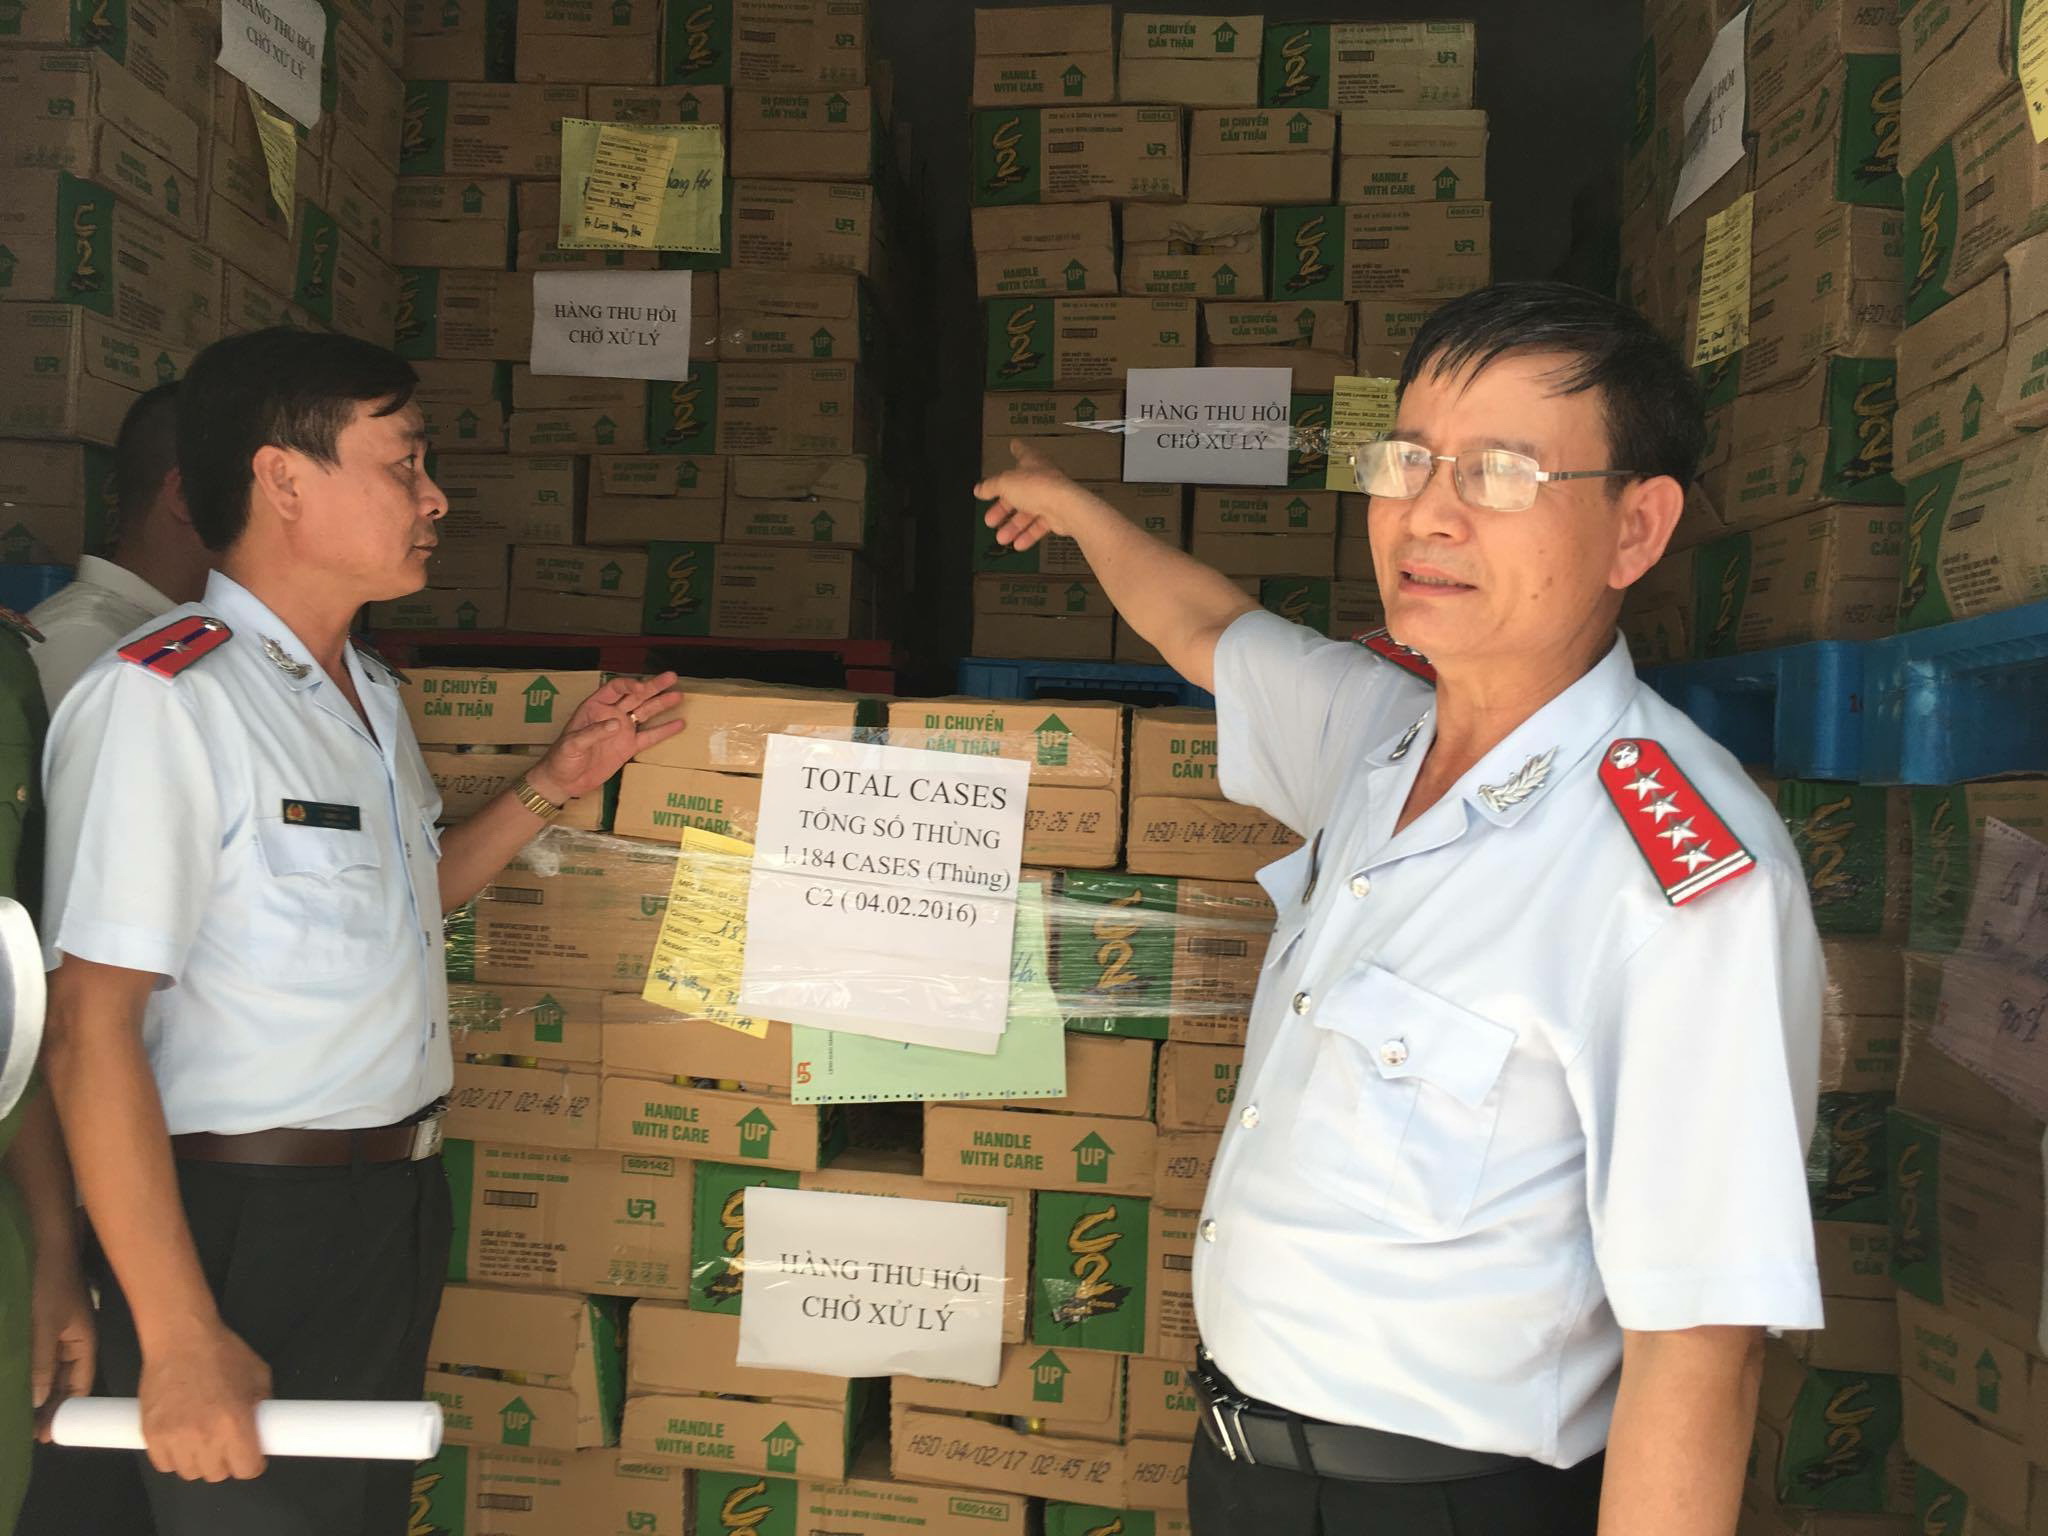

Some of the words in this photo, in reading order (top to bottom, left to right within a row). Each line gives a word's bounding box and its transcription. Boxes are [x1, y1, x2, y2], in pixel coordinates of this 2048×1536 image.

[1147, 24, 1158, 35] DI
[1218, 31, 1233, 42] UP
[1280, 29, 1312, 87] C2
[992, 117, 1022, 178] C2
[1371, 172, 1409, 184] HANDLE
[1440, 178, 1455, 190] UP
[1363, 184, 1388, 196] WITH
[1390, 184, 1416, 196] CARE
[1295, 216, 1328, 275] C2
[1067, 270, 1083, 282] UP
[1217, 274, 1233, 286] UP
[608, 306, 642, 320] THU
[1006, 304, 1038, 363] C2
[1204, 404, 1247, 422] THU
[424, 679, 437, 693] DI
[530, 690, 550, 707] UP
[925, 714, 940, 730] DI
[1170, 739, 1187, 755] DI
[1190, 740, 1218, 756] CHU
[802, 766, 900, 798] TOTAL
[910, 778, 1008, 810] CASES
[667, 792, 724, 814] HANDLE
[652, 809, 691, 829] WITH
[695, 815, 732, 833] CARE
[842, 852, 920, 878] CASES
[805, 886, 834, 908] C2
[1092, 888, 1143, 990] C2
[1214, 1063, 1230, 1079] DI
[645, 1102, 699, 1123] HANDLE
[632, 1120, 671, 1141] WITH
[672, 1123, 710, 1144] CARE
[744, 1123, 767, 1142] UP
[973, 1130, 1032, 1150] HANDLE
[960, 1149, 1000, 1168] WITH
[1003, 1151, 1044, 1171] CARE
[1080, 1147, 1106, 1166] UP
[1068, 1205, 1124, 1300] C2
[868, 1262, 925, 1287] THU
[933, 1265, 982, 1294] HỒI
[802, 1295, 860, 1323] CHỜ
[918, 1307, 956, 1333] LÝ
[1037, 1366, 1062, 1385] UP
[1164, 1371, 1179, 1386] DI
[505, 1411, 530, 1431] UP
[668, 1418, 725, 1439] HANDLE
[655, 1436, 695, 1457] WITH
[697, 1438, 736, 1460] CARE
[771, 1437, 795, 1458] UP
